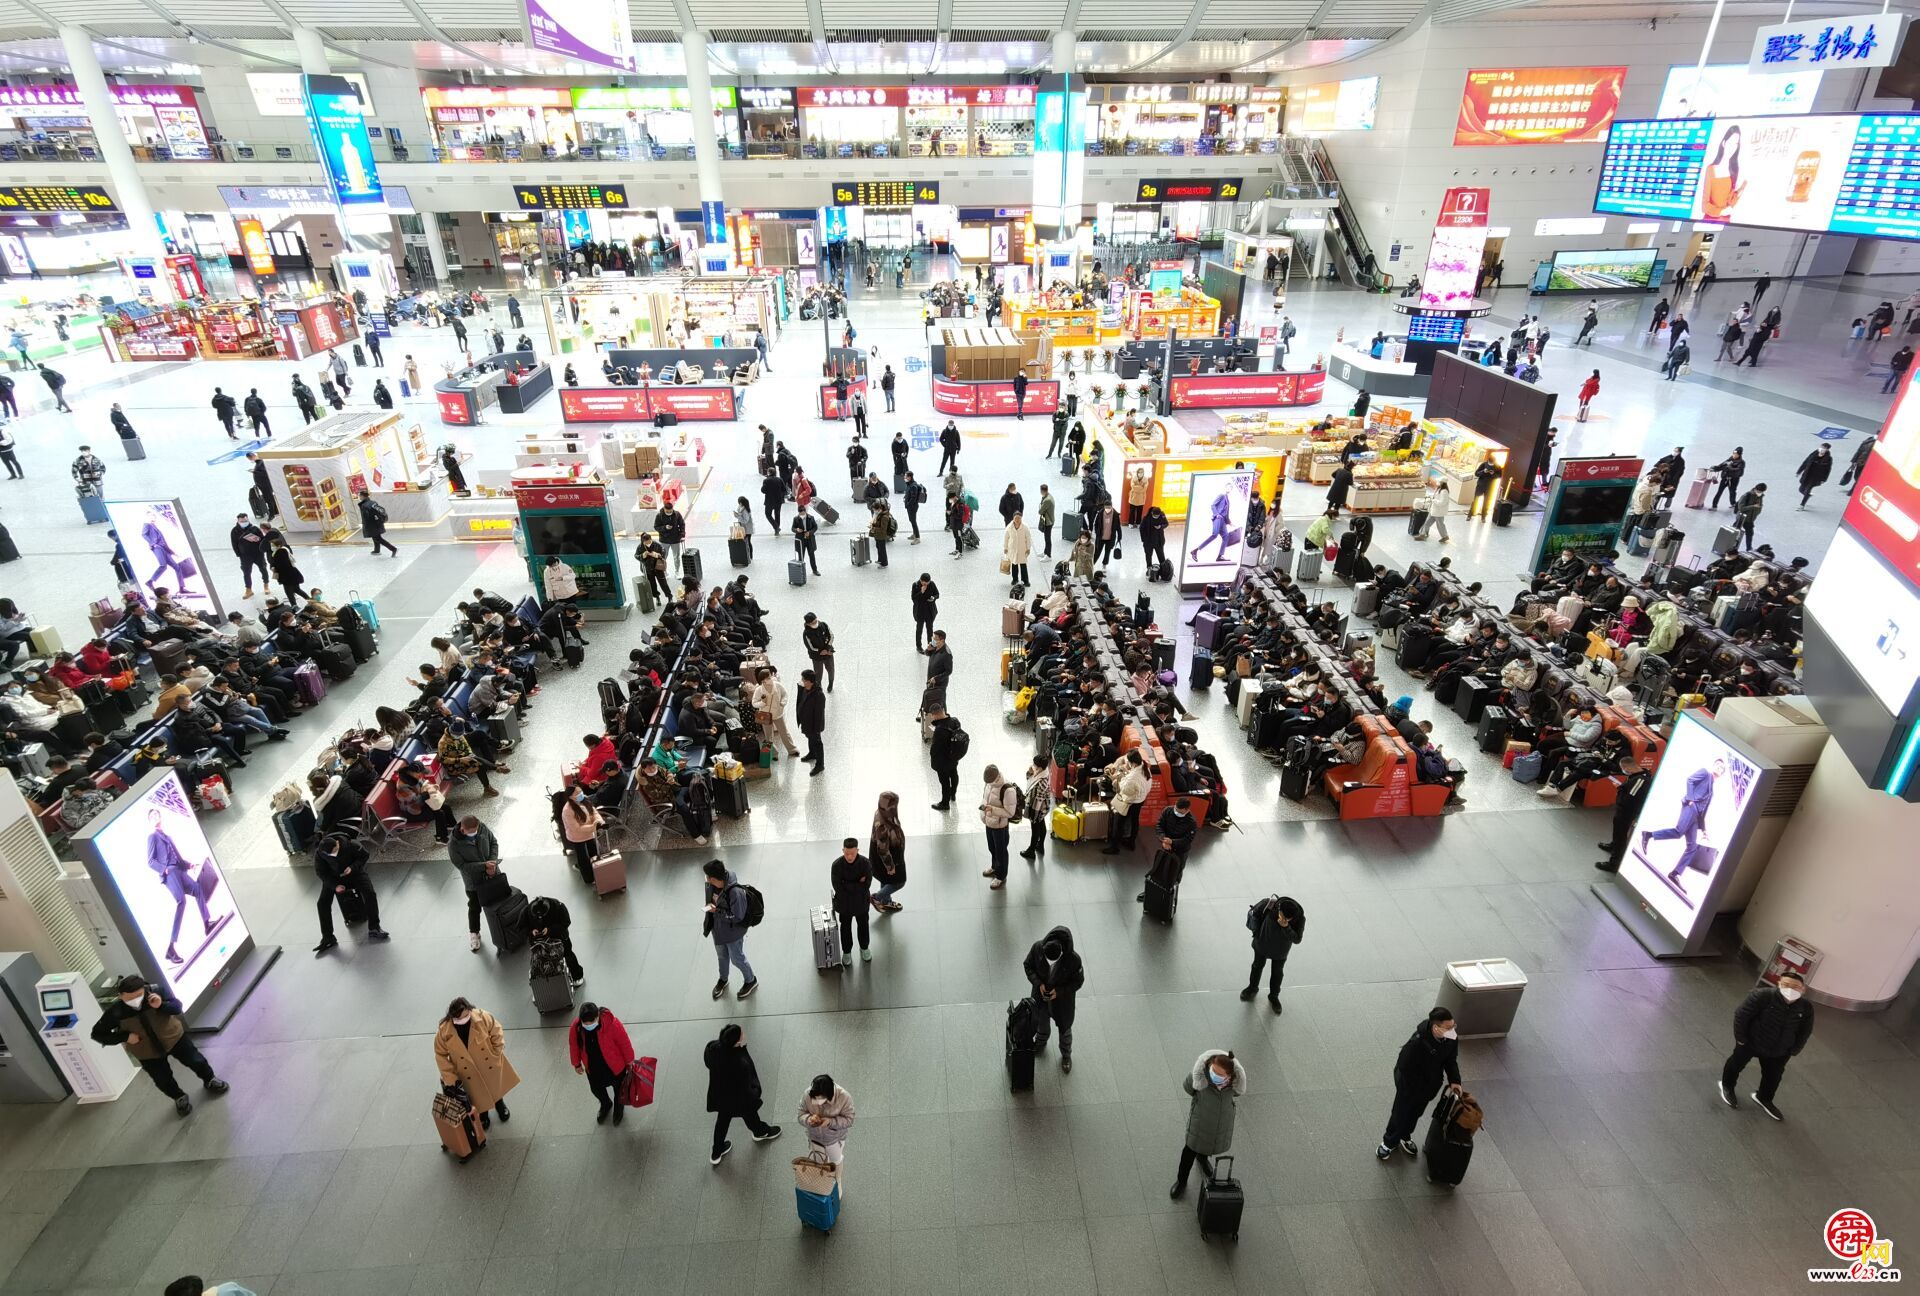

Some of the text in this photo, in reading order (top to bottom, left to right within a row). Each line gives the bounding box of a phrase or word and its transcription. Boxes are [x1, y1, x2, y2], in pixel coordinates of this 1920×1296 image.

[837, 188, 853, 201] 5B
[919, 187, 936, 200] 4B
[1142, 184, 1157, 197] 3B
[1221, 183, 1237, 197] 2B
[84, 192, 112, 206] 10B
[520, 191, 538, 204] 7B
[605, 190, 624, 204] 6B
[1453, 215, 1473, 224] 12306
